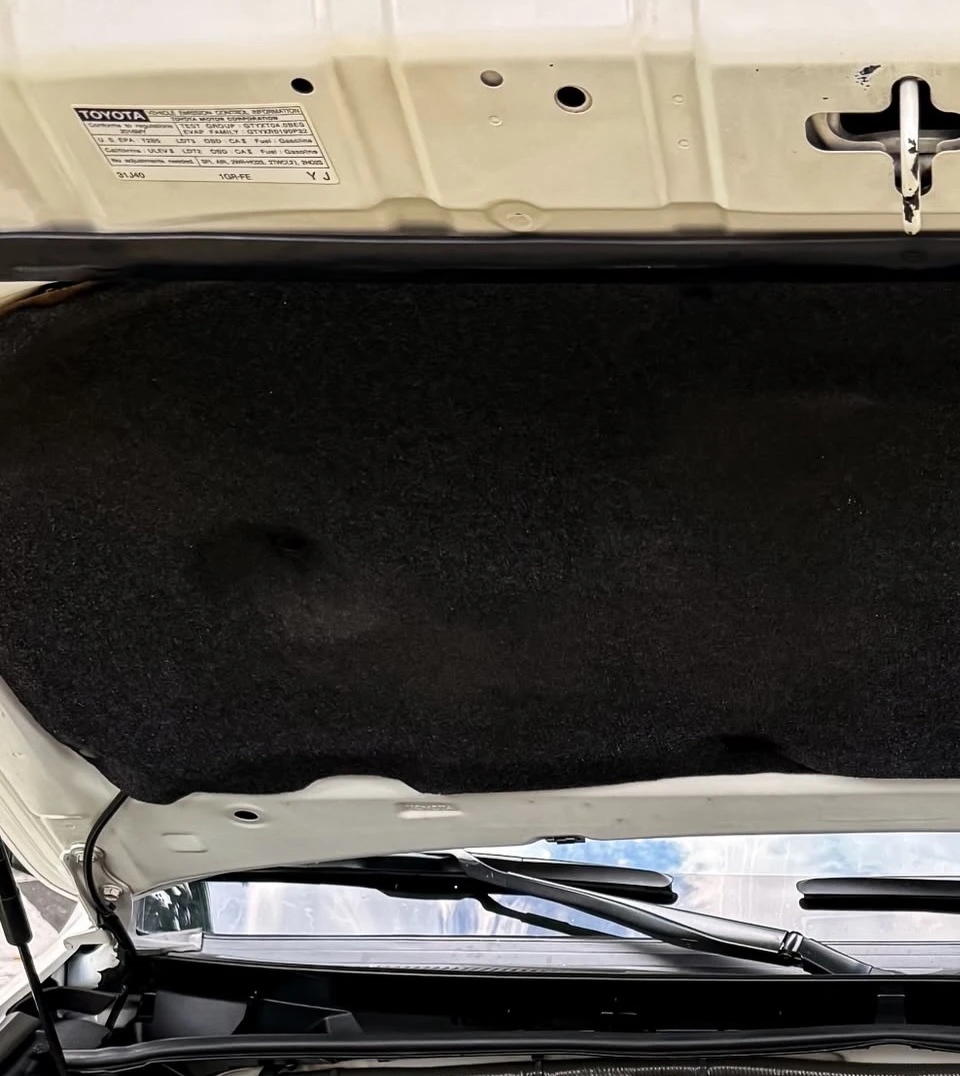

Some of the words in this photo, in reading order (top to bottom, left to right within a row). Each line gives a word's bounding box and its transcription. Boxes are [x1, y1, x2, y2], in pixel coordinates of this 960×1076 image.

[78, 110, 146, 120] TOYOTA
[306, 171, 316, 180] Y
[323, 171, 331, 181] J
